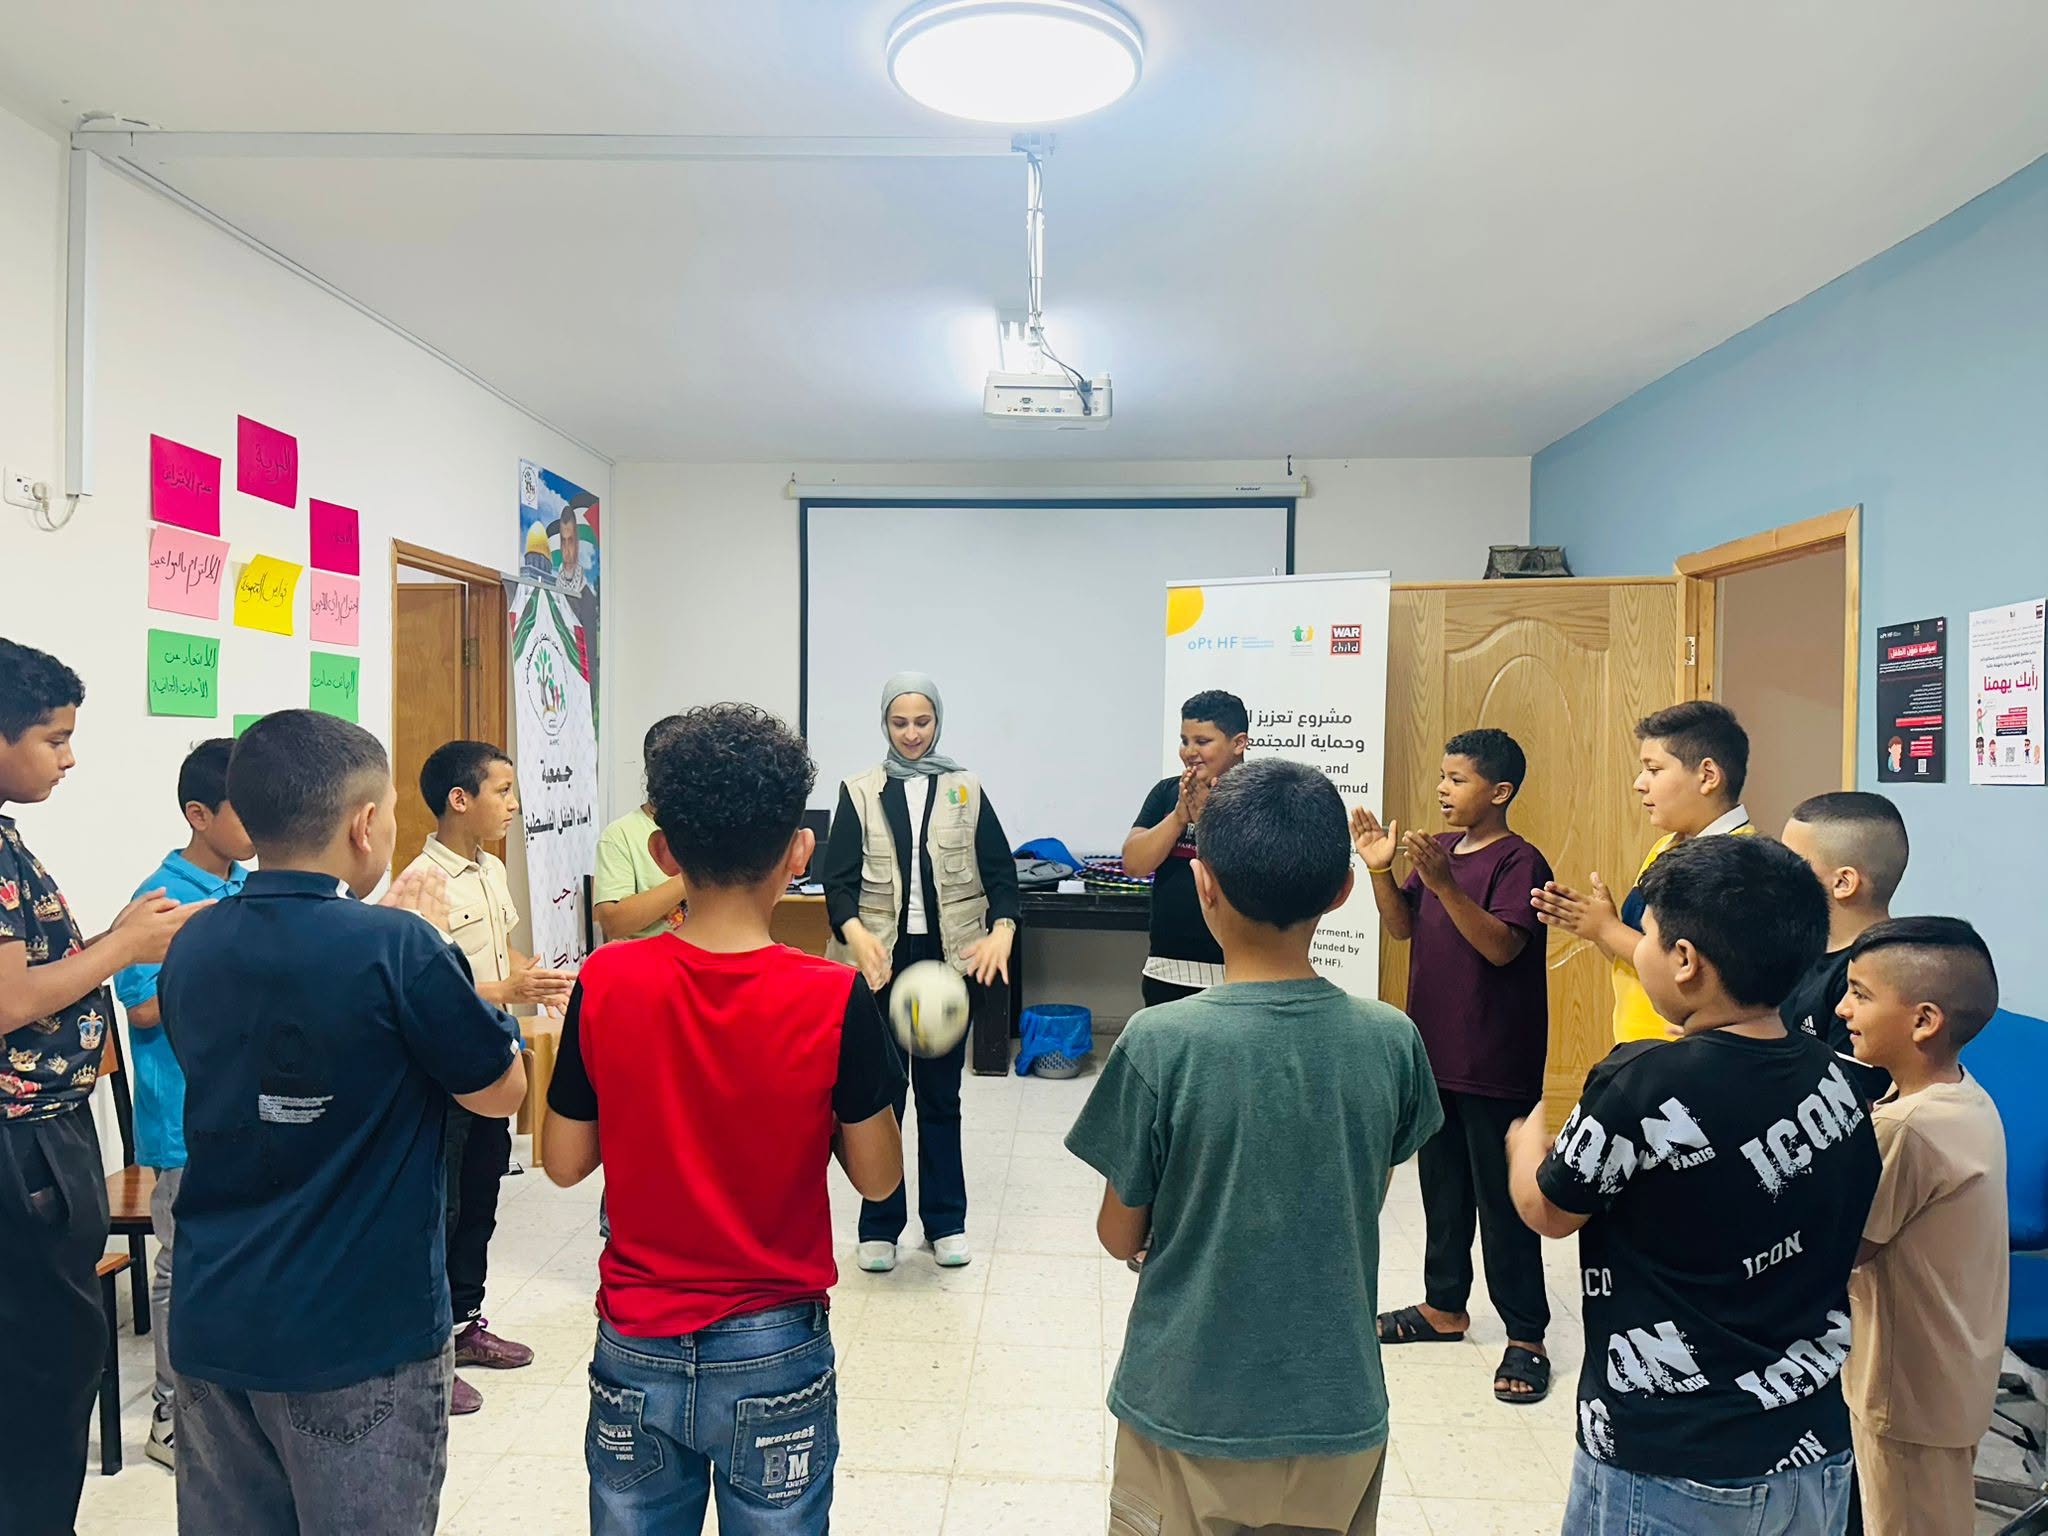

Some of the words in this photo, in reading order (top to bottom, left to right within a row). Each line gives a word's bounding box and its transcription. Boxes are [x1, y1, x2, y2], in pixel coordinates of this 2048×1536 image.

[1333, 626, 1360, 638] WAR
[1187, 637, 1213, 650] oPt
[1217, 636, 1239, 649] HF
[1332, 641, 1359, 653] child
[1983, 675, 2012, 694] يهمنا
[2015, 664, 2038, 691] رأيك
[1256, 709, 1294, 728] تعزيز
[1297, 707, 1353, 728] مشروع
[1310, 733, 1366, 753] وحماية
[540, 759, 573, 791] جمعية
[1325, 763, 1349, 774] and
[1335, 782, 1369, 794] mud
[1316, 928, 1353, 939] erment,
[1355, 930, 1365, 940] in
[1313, 941, 1346, 953] funded
[1347, 945, 1360, 956] by
[1800, 1024, 1817, 1036] adidas
[1739, 1061, 1858, 1200] ICON
[1742, 1229, 1803, 1281] ICON
[1765, 1429, 1828, 1475] CON
[761, 1446, 788, 1488] B
[787, 1450, 811, 1482] M
